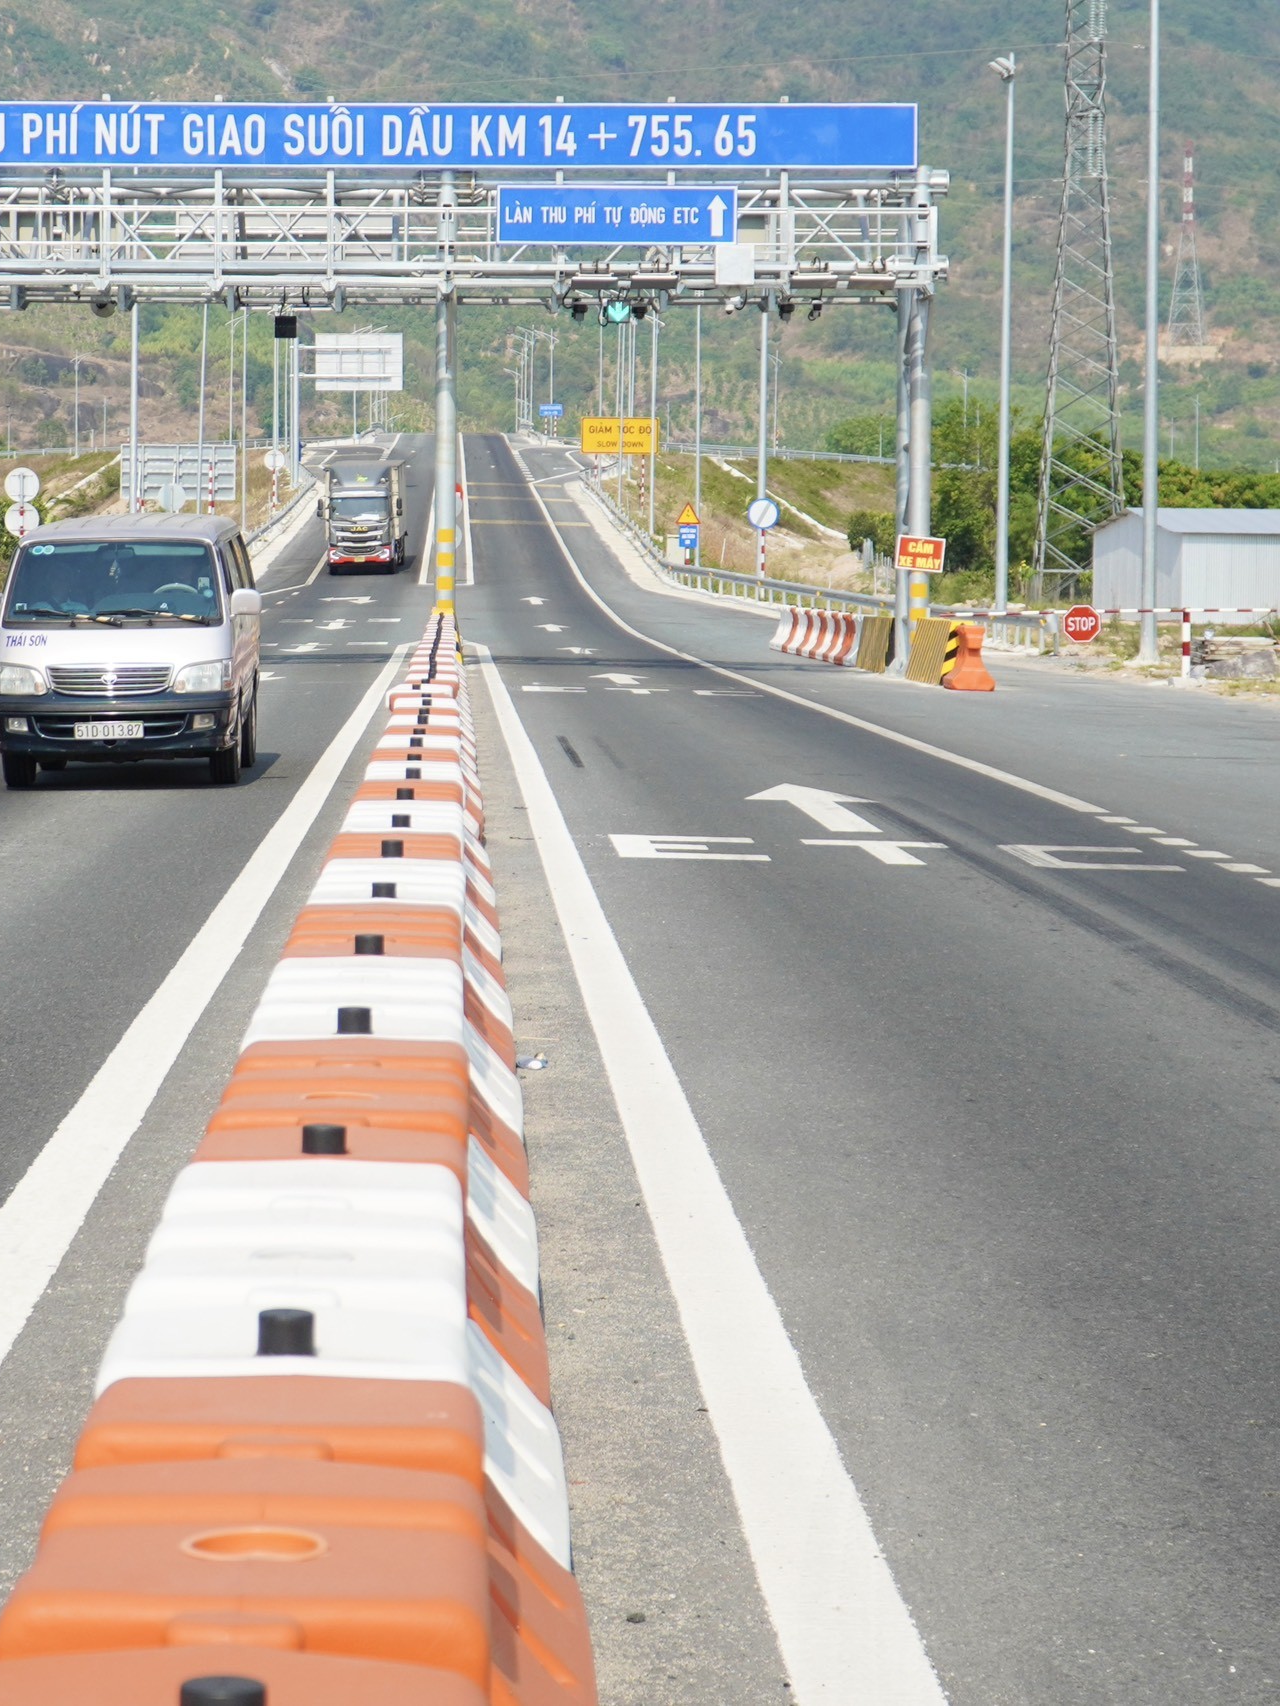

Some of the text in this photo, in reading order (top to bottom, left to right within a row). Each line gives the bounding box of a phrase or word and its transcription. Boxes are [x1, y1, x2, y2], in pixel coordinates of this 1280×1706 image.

[22, 105, 84, 155] PHÍ
[94, 105, 165, 156] NÚT
[183, 113, 266, 157] GIAO
[283, 106, 364, 157] SUỐI
[382, 106, 453, 157] DẦU
[470, 115, 526, 157] KM
[505, 200, 699, 228] LÀN THU PHÍ TỰ ĐỘNG ETC
[597, 440, 617, 448] SLOW
[908, 540, 935, 555] CẤM
[899, 555, 941, 569] XE MÁY
[1067, 616, 1096, 632] STOP
[6, 632, 48, 647] THÁI SƠN
